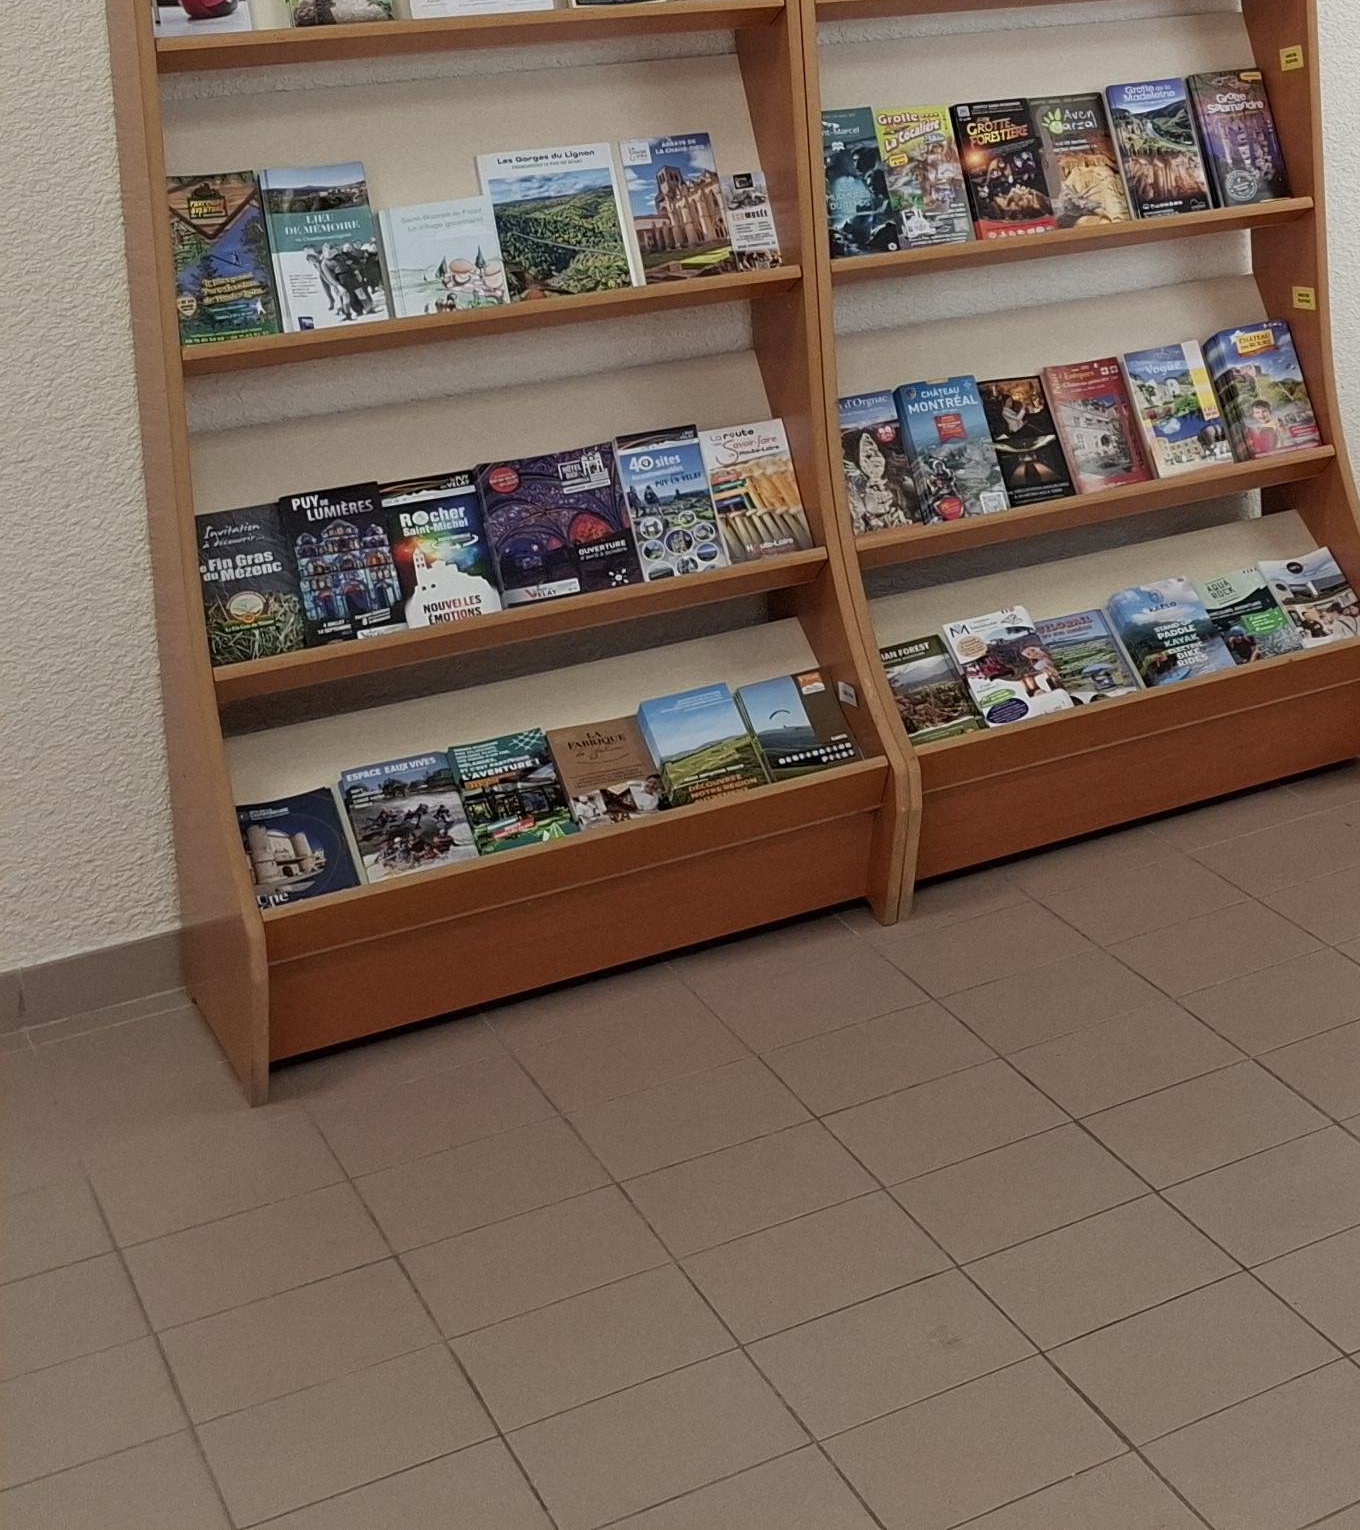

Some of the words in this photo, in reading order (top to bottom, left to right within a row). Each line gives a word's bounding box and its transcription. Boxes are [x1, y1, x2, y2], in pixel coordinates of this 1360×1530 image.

[1123, 90, 1176, 102] Madeleine
[1124, 85, 1155, 95] Grotte
[1216, 92, 1247, 104] Grotte
[877, 113, 920, 126] Grotte
[1063, 109, 1094, 120] Aven
[884, 138, 898, 152] La
[898, 120, 941, 144] Cocalière
[497, 157, 513, 165] Les
[515, 154, 549, 165] Gorges
[551, 152, 563, 160] du
[564, 149, 596, 161] Lignon
[305, 213, 334, 224] LIEU
[285, 225, 301, 235] DE
[302, 219, 361, 235] MÉMOIRE
[921, 386, 960, 399] CHÂTEAU
[843, 394, 888, 409] d'Orgnac
[907, 394, 979, 415] MONTRÉAL
[709, 434, 722, 442] La
[722, 428, 754, 441] route
[655, 454, 681, 468] sites
[654, 479, 669, 488] PUY
[291, 495, 319, 511] PUY
[306, 498, 374, 522] LUMIÈRES
[399, 506, 466, 528] Rocher
[203, 523, 261, 540] Invitation
[402, 517, 469, 538] Saint-Michel
[578, 539, 627, 556] OUVERTURE
[208, 556, 233, 572] Fin
[235, 550, 274, 566] Gras
[203, 571, 219, 582] du
[220, 561, 283, 582] Mézenc
[1206, 579, 1232, 593] AQUA
[1211, 586, 1236, 600] ROCK
[423, 594, 482, 614] NOUVELLES
[428, 606, 482, 626] ÉMOTIONS
[1157, 624, 1197, 640] PADDLE
[1163, 633, 1200, 647] KAYAK
[899, 641, 930, 656] FOREST
[1176, 647, 1202, 660] BIKE
[1176, 653, 1209, 667] RIDES
[567, 733, 627, 750] FABRIQUE
[346, 768, 382, 782] ESPACE
[384, 761, 409, 774] EAUX
[409, 756, 437, 770] VIVES
[461, 759, 533, 781] L'AVENTURE
[688, 773, 743, 792] DÉCOUVREZ
[690, 787, 723, 800] NOTRE
[724, 776, 758, 793] RÉGION
